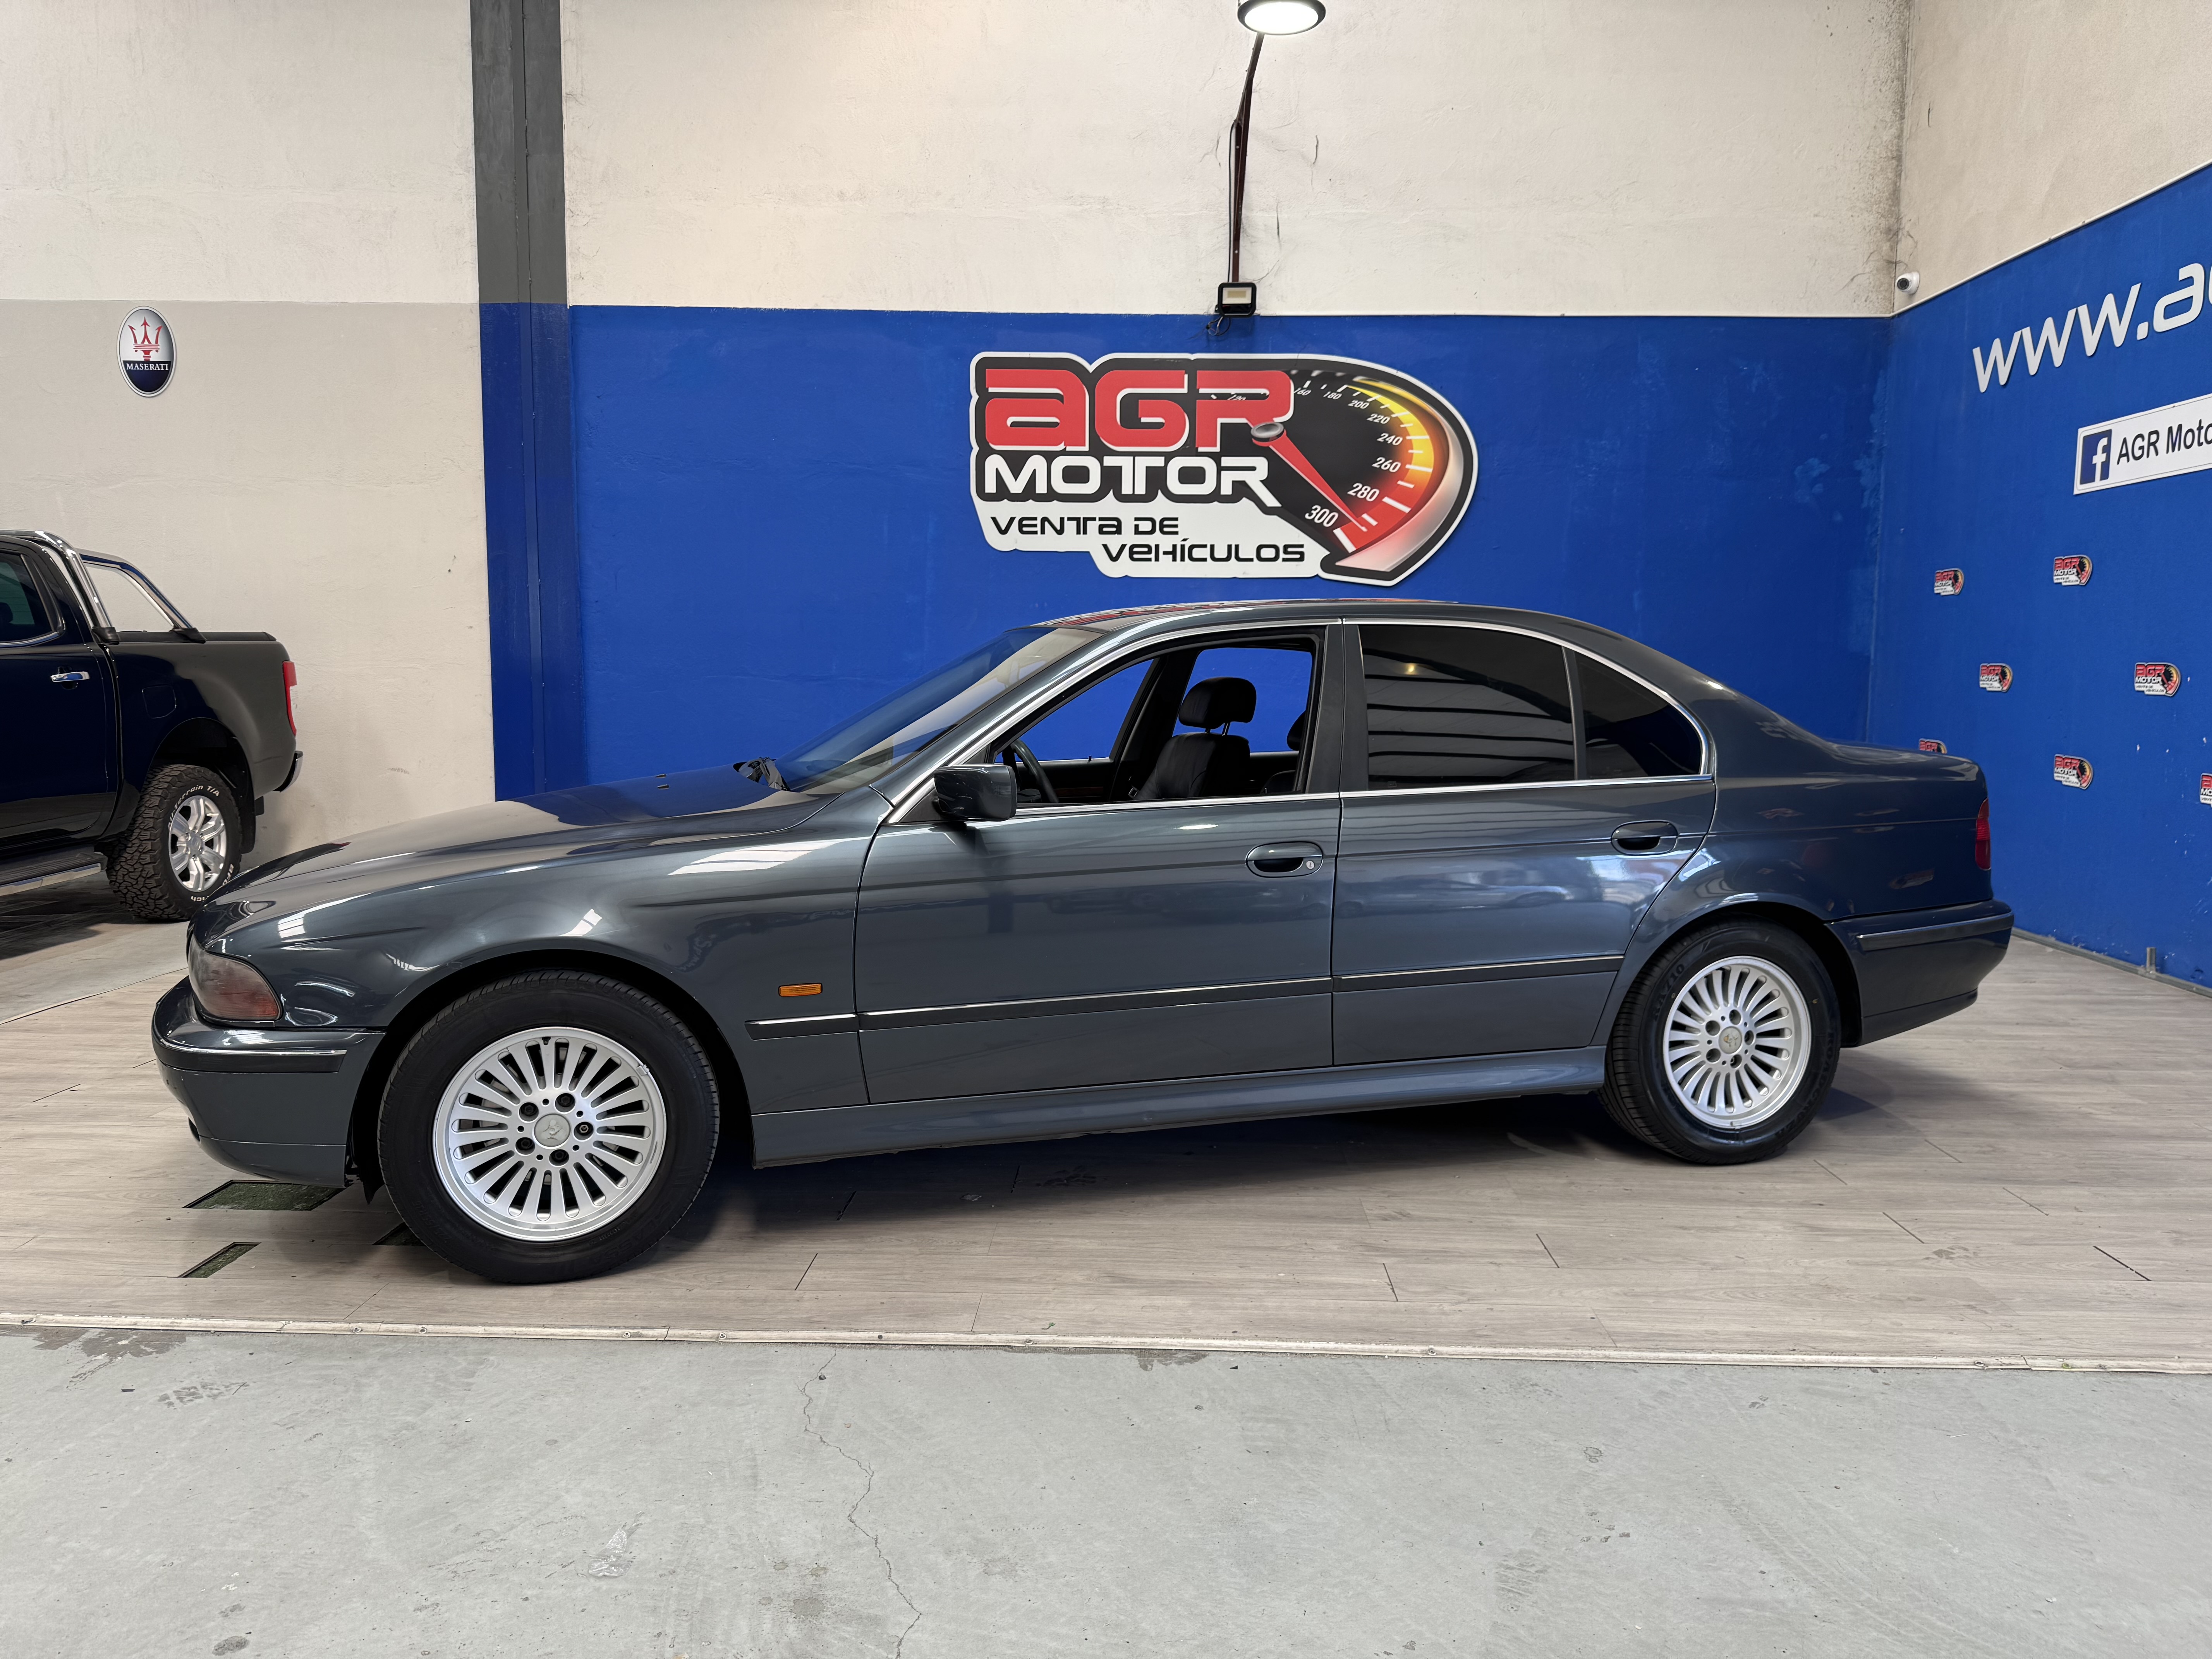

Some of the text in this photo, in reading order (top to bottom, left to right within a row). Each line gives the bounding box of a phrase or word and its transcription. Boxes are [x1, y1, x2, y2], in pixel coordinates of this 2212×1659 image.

[1972, 262, 2212, 393] www.a
[1294, 388, 1311, 396] 160
[1323, 391, 1342, 400] 180
[1348, 400, 1369, 409] 200
[1367, 414, 1391, 424] 220
[1377, 433, 1403, 445] 240
[2117, 429, 2160, 465] AGR
[1372, 457, 1401, 472] 260
[985, 454, 1282, 507] MOTOR
[1347, 483, 1379, 501] 280
[1305, 505, 1338, 527] 300
[1134, 517, 1179, 535] DE
[207, 785, 220, 796] T/A
